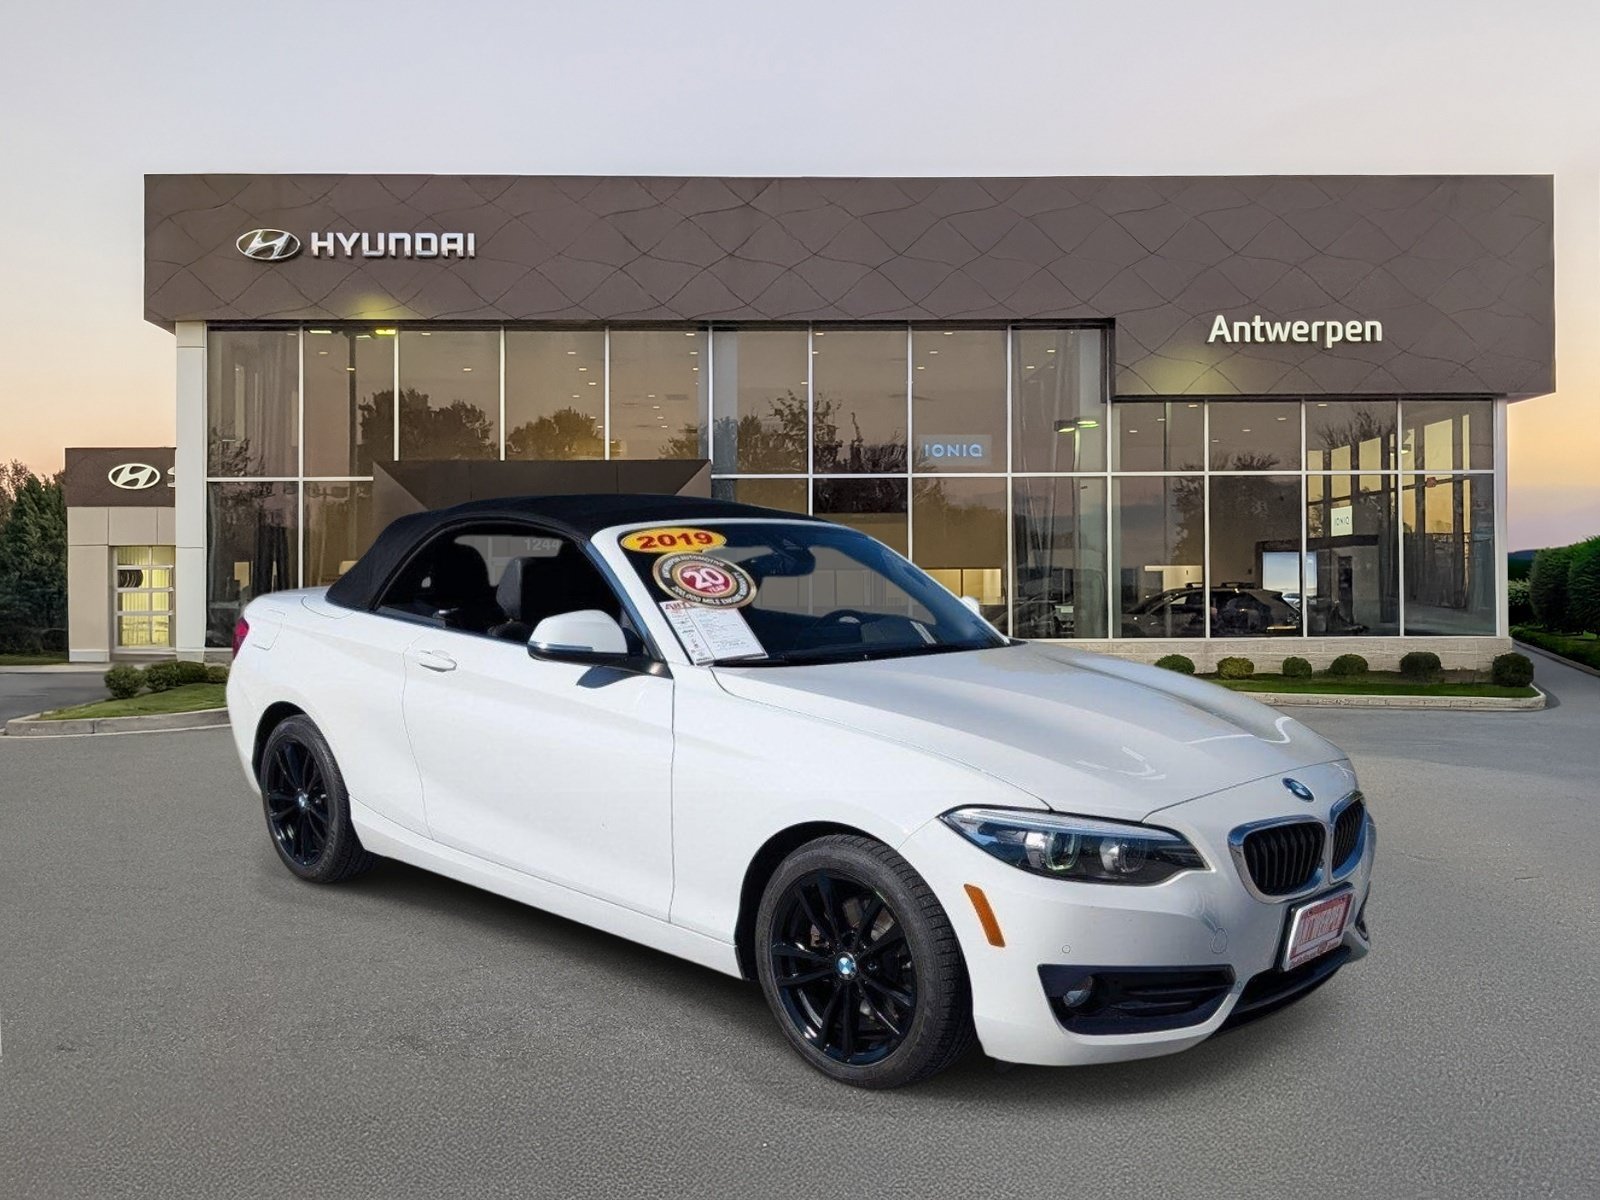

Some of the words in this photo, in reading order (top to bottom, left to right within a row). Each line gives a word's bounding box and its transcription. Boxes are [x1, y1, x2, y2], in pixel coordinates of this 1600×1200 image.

[310, 231, 476, 258] HYUNDAI
[1207, 314, 1383, 349] Antwerpen
[924, 443, 983, 458] IONIQ
[636, 532, 713, 550] 2019
[682, 567, 726, 590] 20
